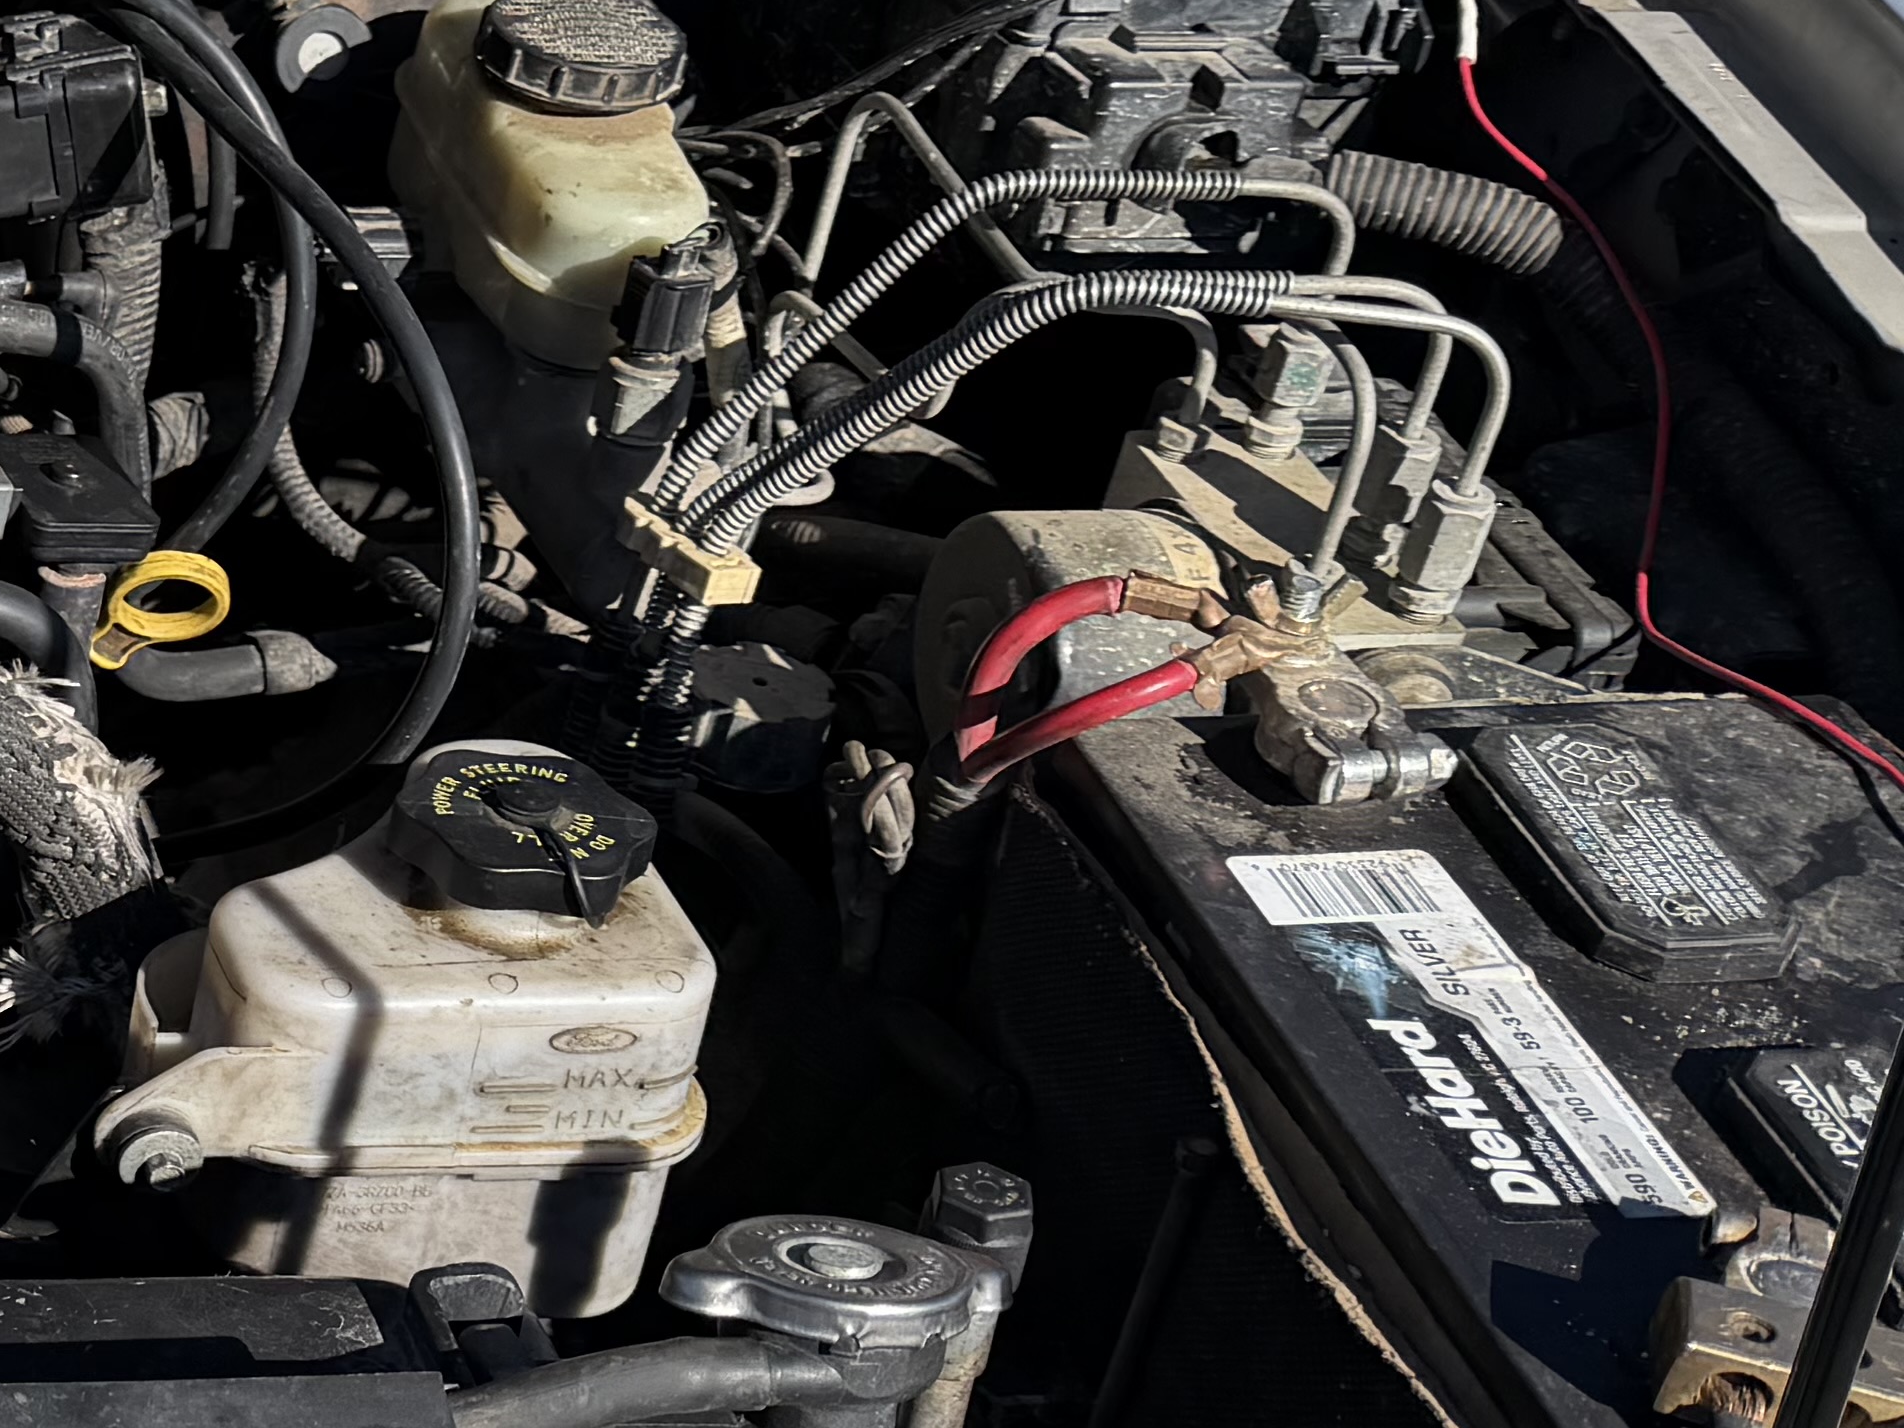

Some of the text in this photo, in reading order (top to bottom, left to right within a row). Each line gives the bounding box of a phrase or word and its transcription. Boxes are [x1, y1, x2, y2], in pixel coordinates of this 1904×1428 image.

[431, 776, 462, 815] POWER
[459, 763, 568, 783] STEERING
[1399, 929, 1470, 997] SILVER
[1502, 1017, 1541, 1050] 59-3
[564, 1069, 632, 1088] MAX
[555, 1111, 623, 1130] MIN
[1366, 1019, 1561, 1206] DieHard
[1564, 1097, 1598, 1124] 100
[1777, 1078, 1859, 1156] POISON
[1625, 1174, 1663, 1205] 590
